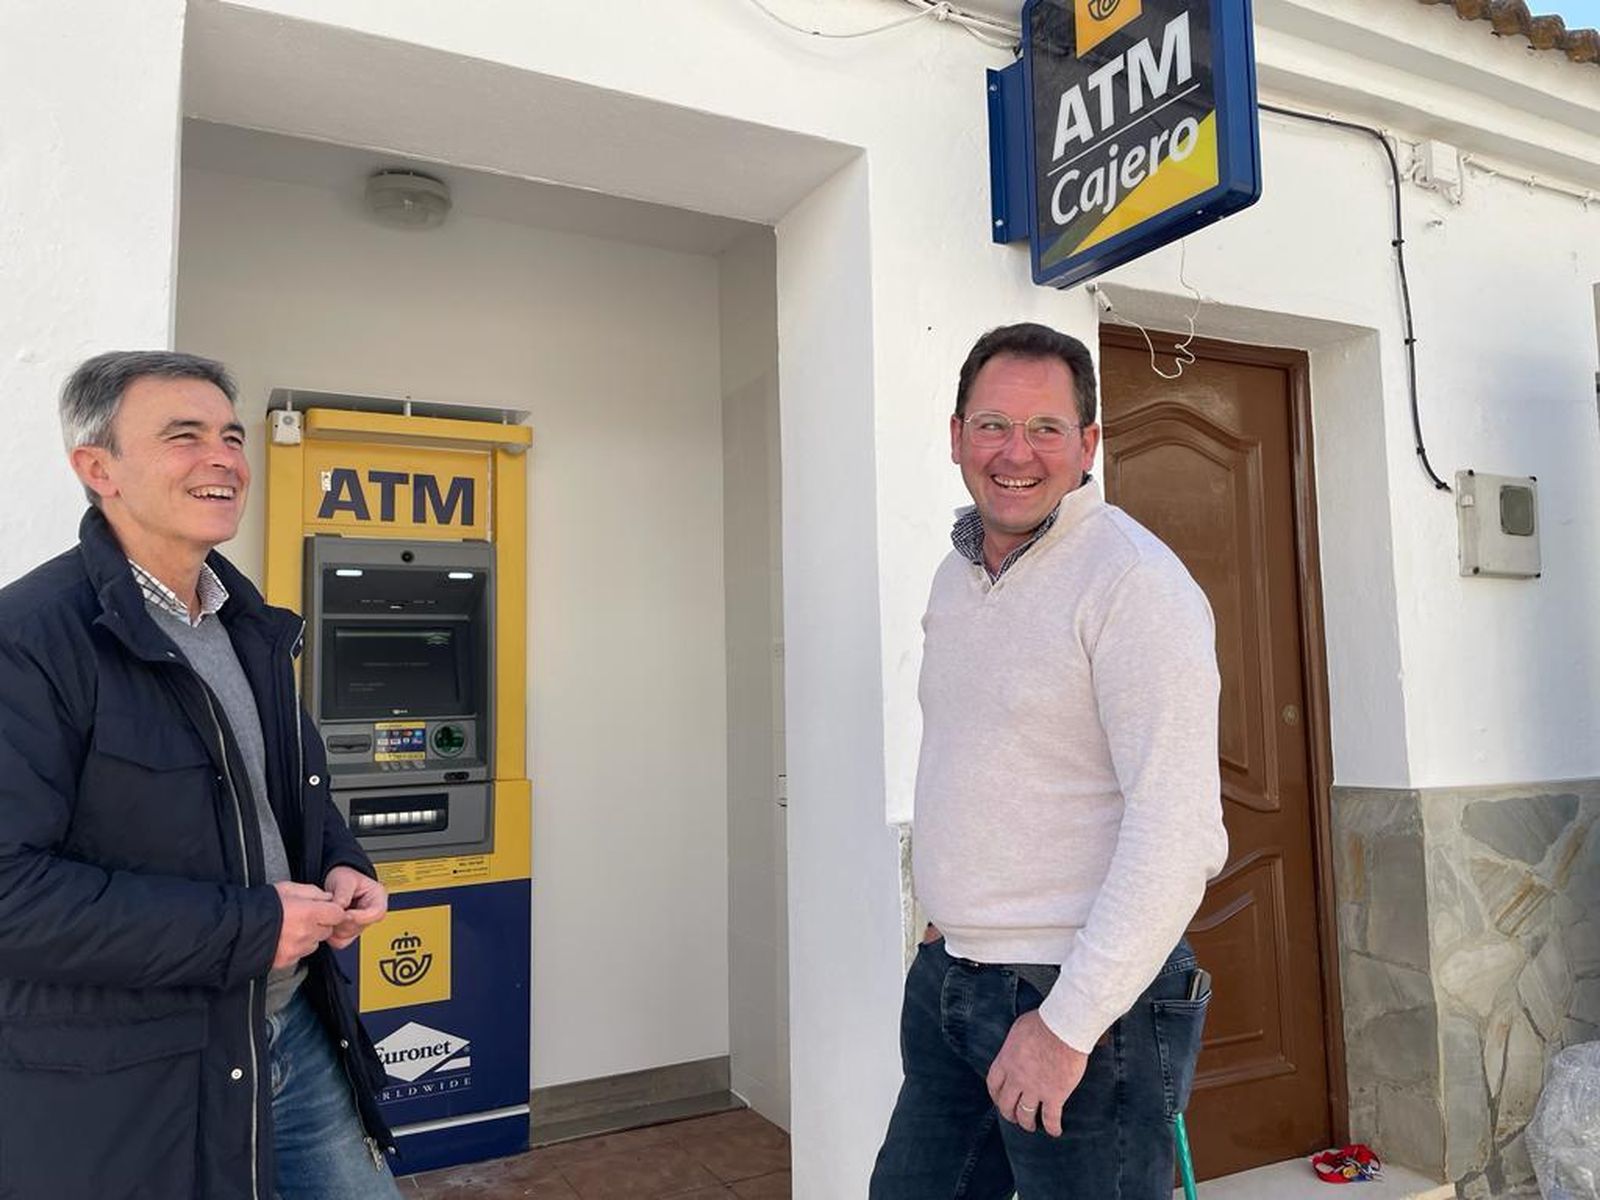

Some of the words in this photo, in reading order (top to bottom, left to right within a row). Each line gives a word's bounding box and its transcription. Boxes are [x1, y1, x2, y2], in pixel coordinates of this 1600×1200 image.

[1052, 10, 1193, 162] ATM
[1050, 116, 1200, 226] Cajero
[317, 468, 475, 526] ATM
[374, 1077, 472, 1101] RLDWIDE
